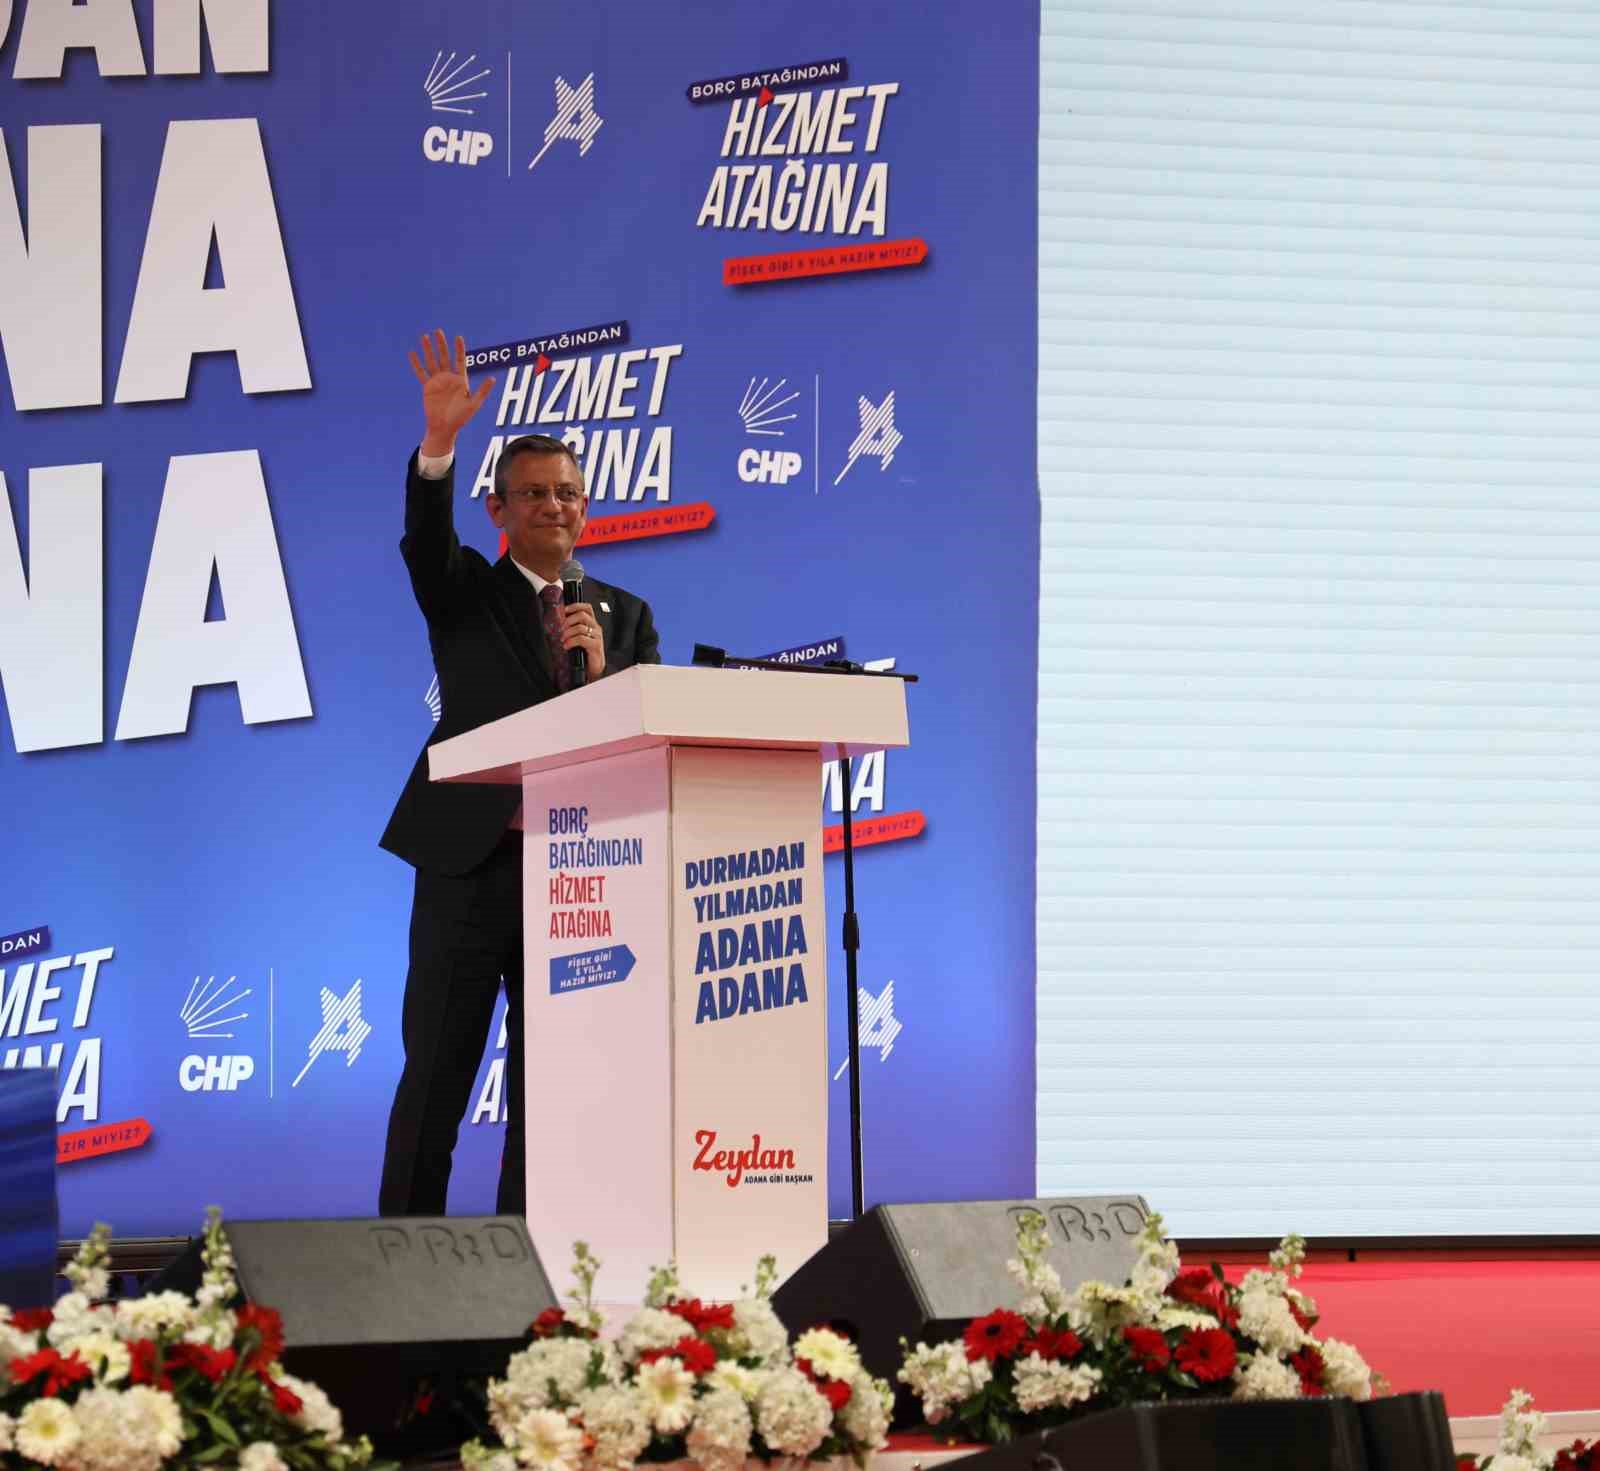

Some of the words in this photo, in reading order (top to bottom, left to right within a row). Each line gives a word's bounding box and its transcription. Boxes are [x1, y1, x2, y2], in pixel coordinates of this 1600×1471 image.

[692, 80, 736, 98] BORÇ
[741, 63, 841, 90] BATAĞINDAN
[720, 83, 899, 157] HİZMET
[423, 126, 493, 165] CHP
[697, 159, 889, 236] ATAĞINA
[465, 348, 511, 367] BORÇ
[517, 326, 622, 357] BATAĞINDAN
[496, 344, 683, 427] HİZMET
[738, 448, 802, 485] CHP
[549, 806, 588, 838] BORÇ
[549, 837, 643, 869] BATAĞINDAN
[685, 842, 805, 889] DURMADAN
[549, 871, 606, 904] HİZMET
[693, 878, 803, 923] YILMADAN
[549, 908, 612, 939] ATAĞINA
[695, 914, 808, 975] ADANA
[695, 962, 809, 1025] ADANA
[179, 1054, 254, 1091] CHP
[63, 1138, 86, 1153] ZIR
[692, 1129, 796, 1187] Zeydan
[744, 1175, 768, 1184] ADANA
[785, 1174, 813, 1185] BAŞKAN
